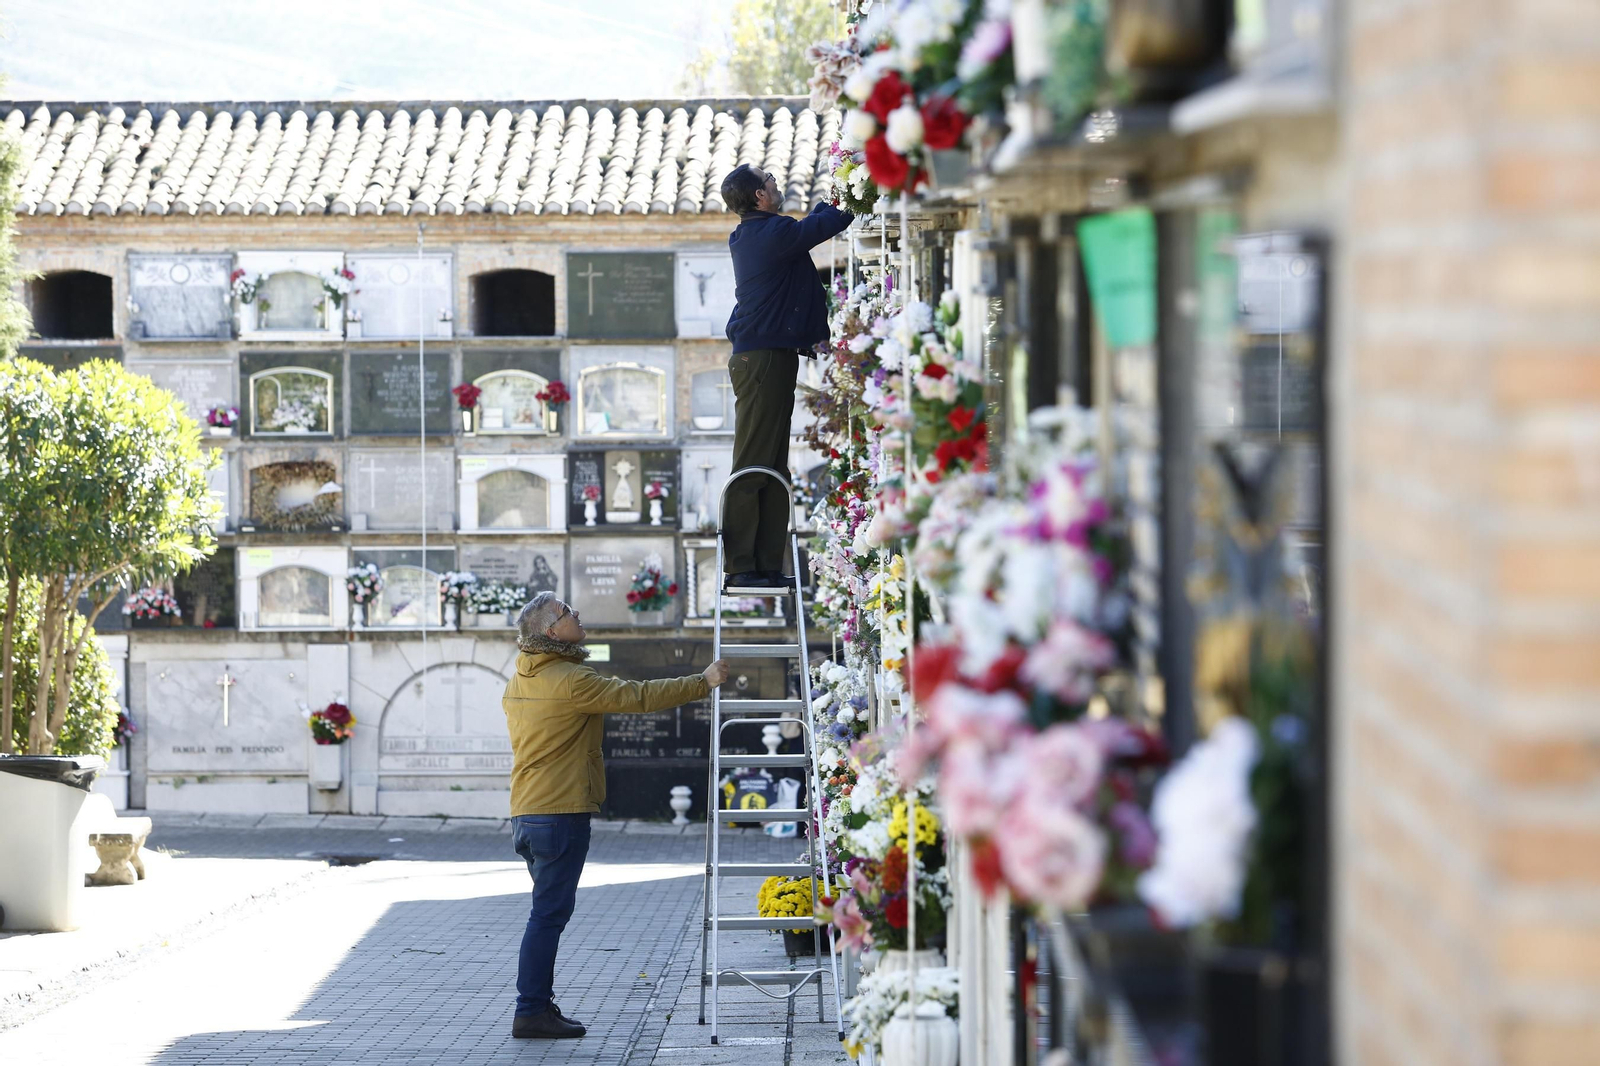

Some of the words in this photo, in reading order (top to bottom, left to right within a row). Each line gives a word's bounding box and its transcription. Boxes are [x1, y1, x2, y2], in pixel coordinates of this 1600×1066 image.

[586, 555, 622, 564] FAMILIA
[172, 746, 207, 754] FAMILIA
[241, 746, 284, 754] REDONDO
[611, 749, 651, 757] FAMILIA
